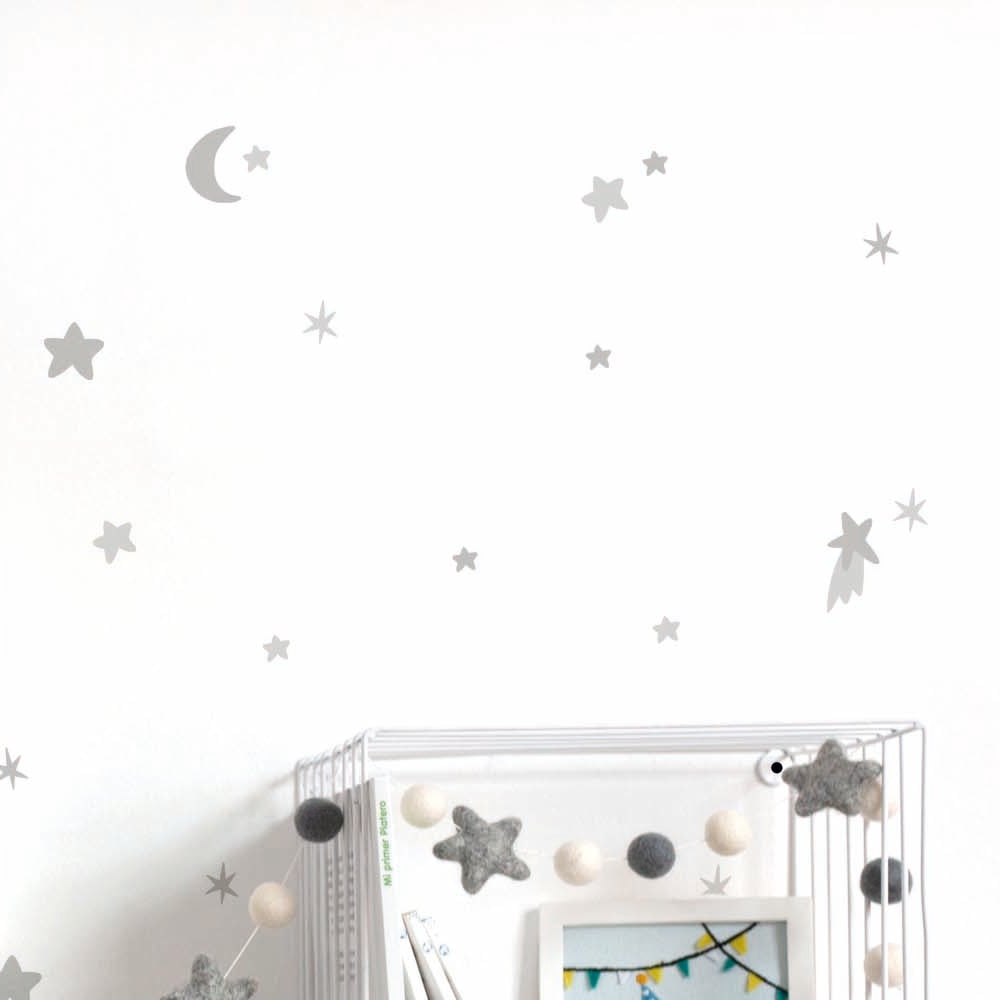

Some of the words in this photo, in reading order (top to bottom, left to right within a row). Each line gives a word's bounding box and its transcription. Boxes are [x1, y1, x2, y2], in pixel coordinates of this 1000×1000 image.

[379, 800, 388, 836] Platero
[382, 839, 392, 871] primer
[384, 874, 393, 887] Mi
